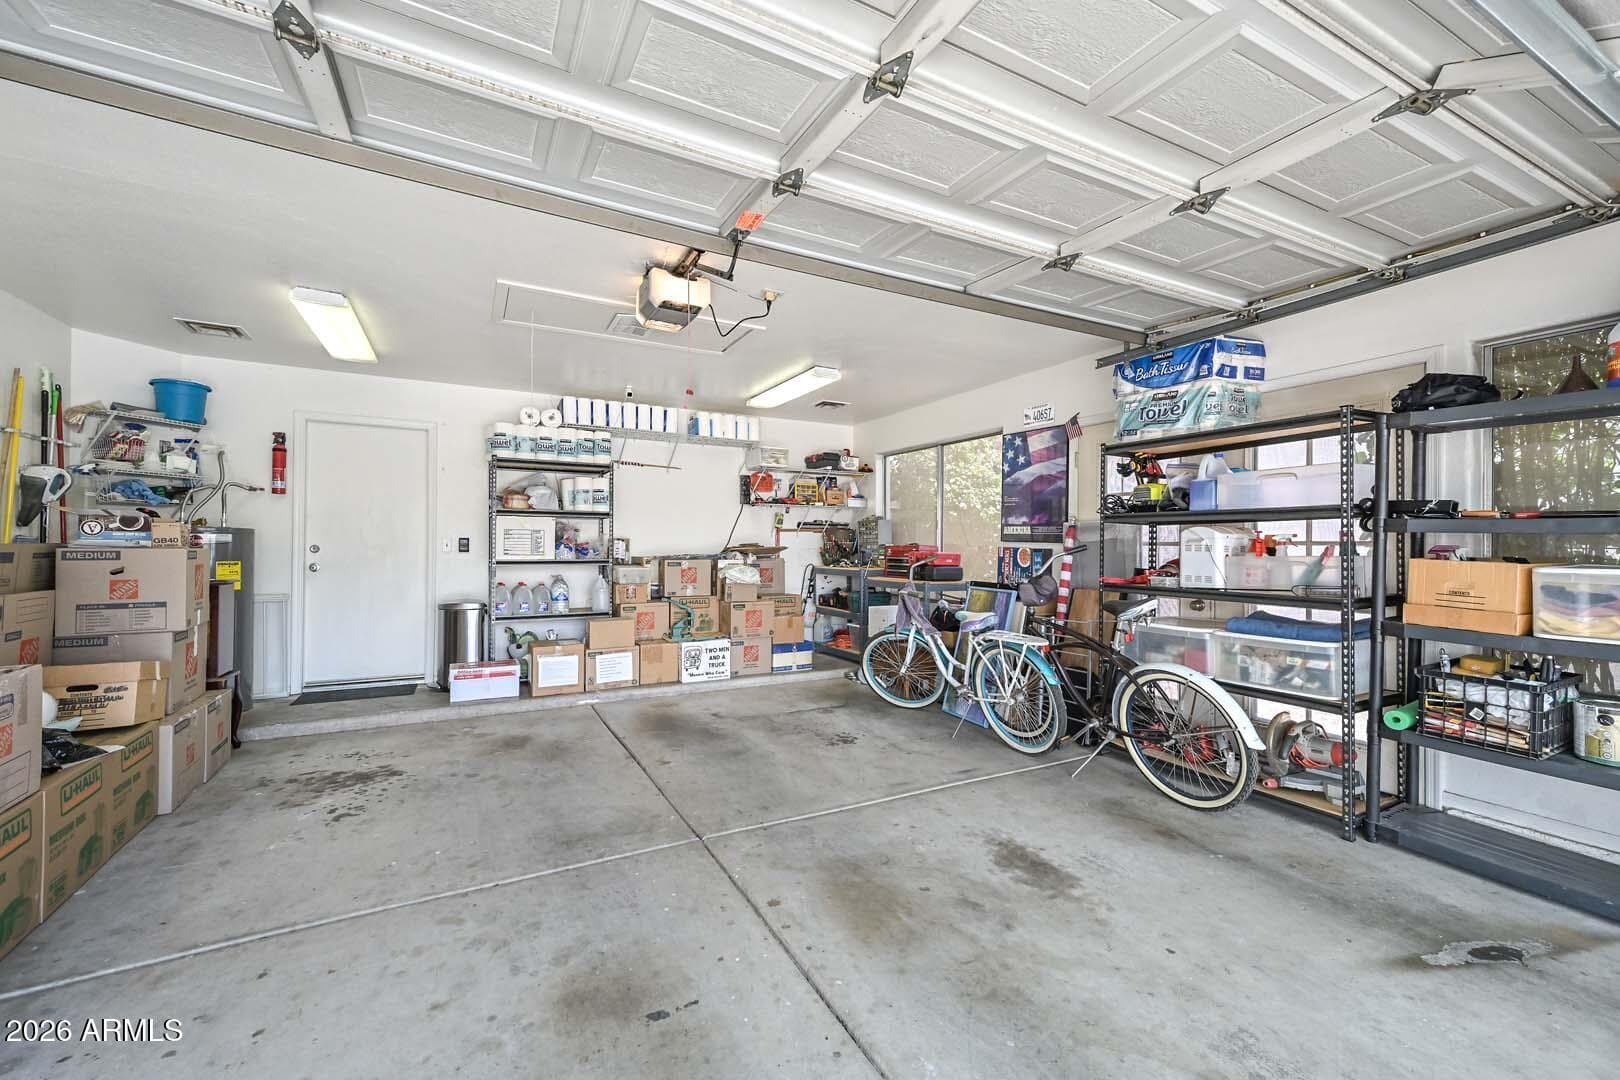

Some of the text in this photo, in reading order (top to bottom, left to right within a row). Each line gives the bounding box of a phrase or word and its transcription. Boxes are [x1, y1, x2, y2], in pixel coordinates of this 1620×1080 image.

[1136, 364, 1159, 381] Bath
[1140, 399, 1187, 421] Towel
[65, 551, 117, 560] MEDIUM
[54, 638, 105, 648] MEDIUM
[63, 768, 100, 803] U-HAUL
[0, 816, 29, 845] AUL
